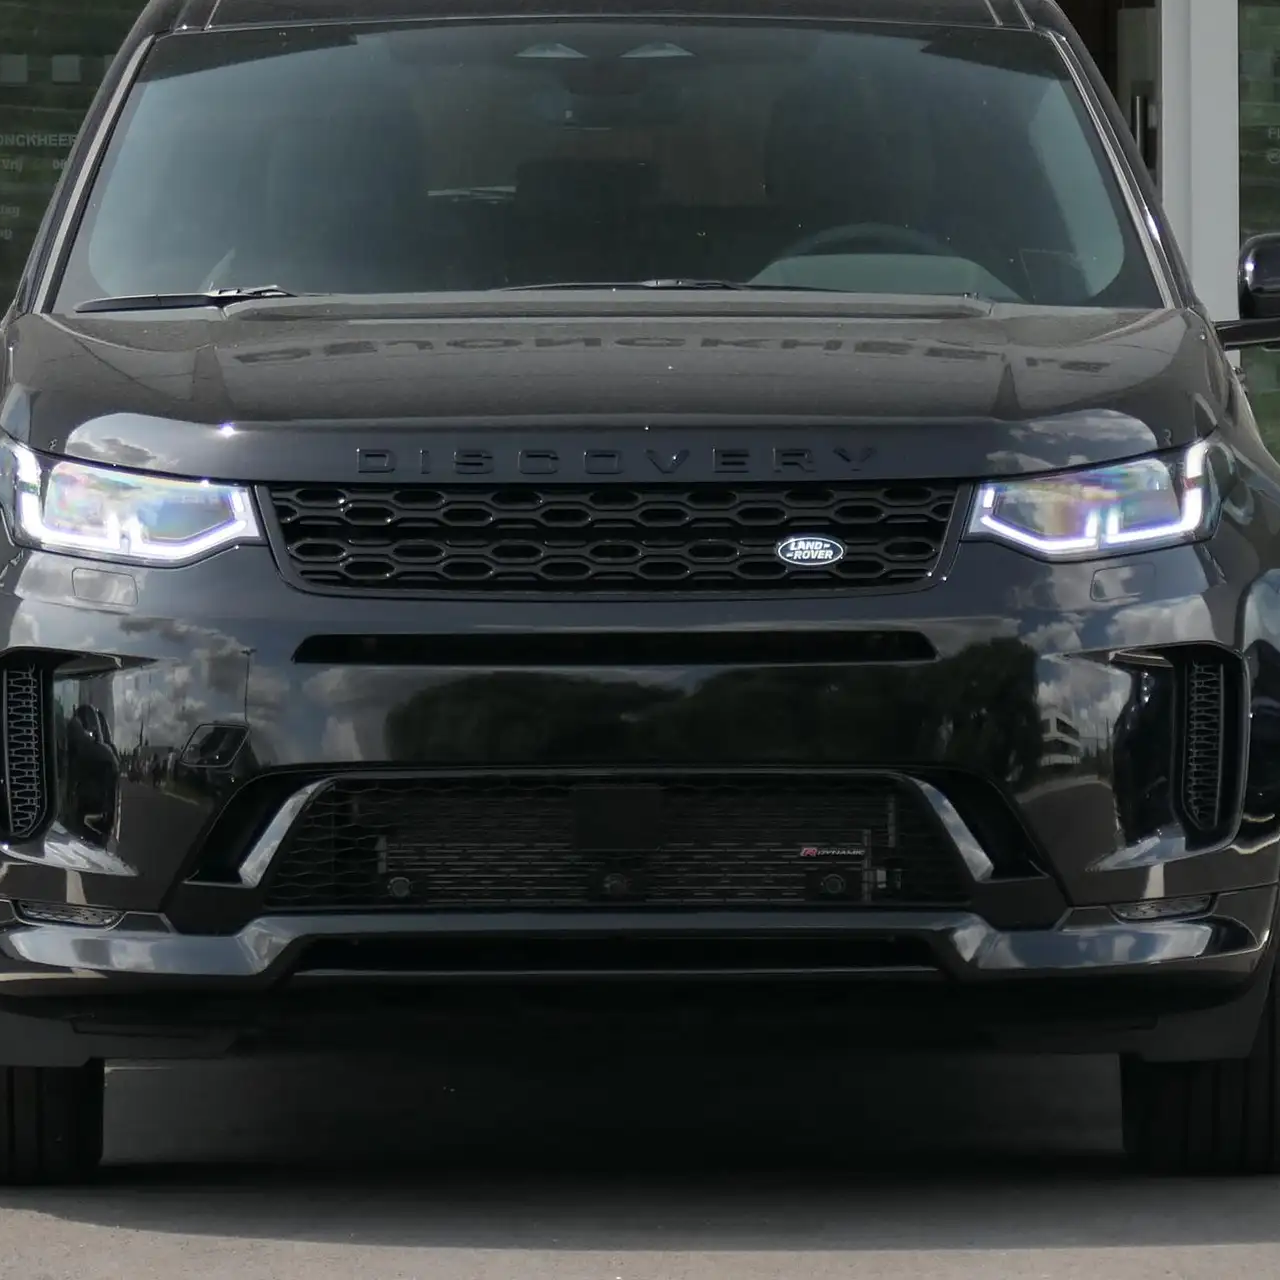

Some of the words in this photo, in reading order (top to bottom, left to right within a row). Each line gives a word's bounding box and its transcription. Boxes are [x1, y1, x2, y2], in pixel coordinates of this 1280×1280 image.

[355, 446, 879, 475] DISCOVERY
[790, 540, 823, 551] LAND
[793, 549, 834, 560] ROVER
